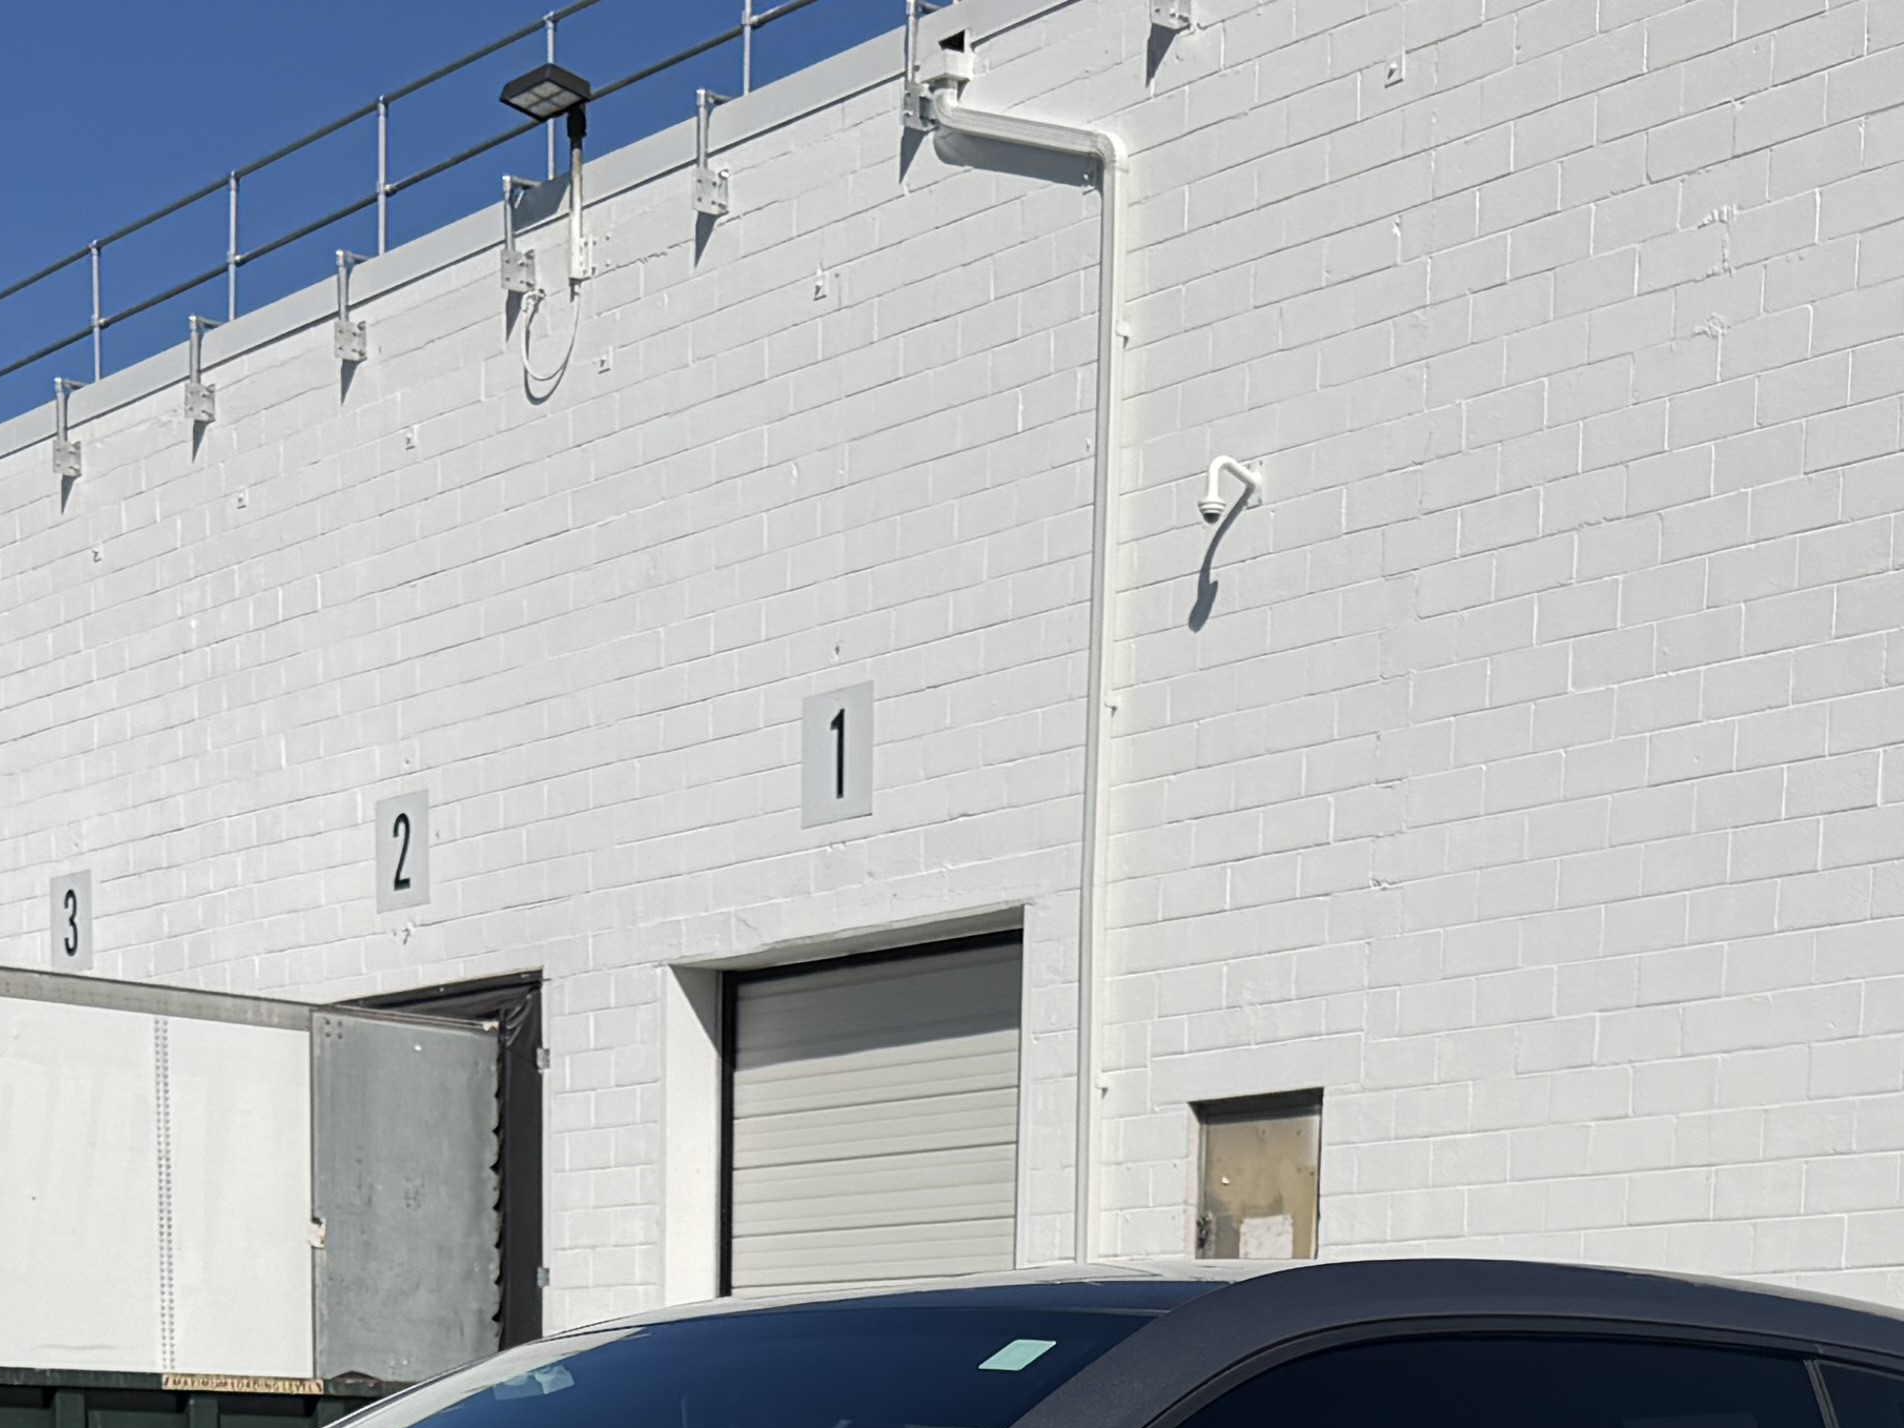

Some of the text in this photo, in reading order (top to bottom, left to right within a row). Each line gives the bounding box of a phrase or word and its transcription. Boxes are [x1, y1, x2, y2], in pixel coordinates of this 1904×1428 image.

[831, 709, 844, 798] 1
[394, 813, 410, 890] 2
[65, 890, 77, 956] 3
